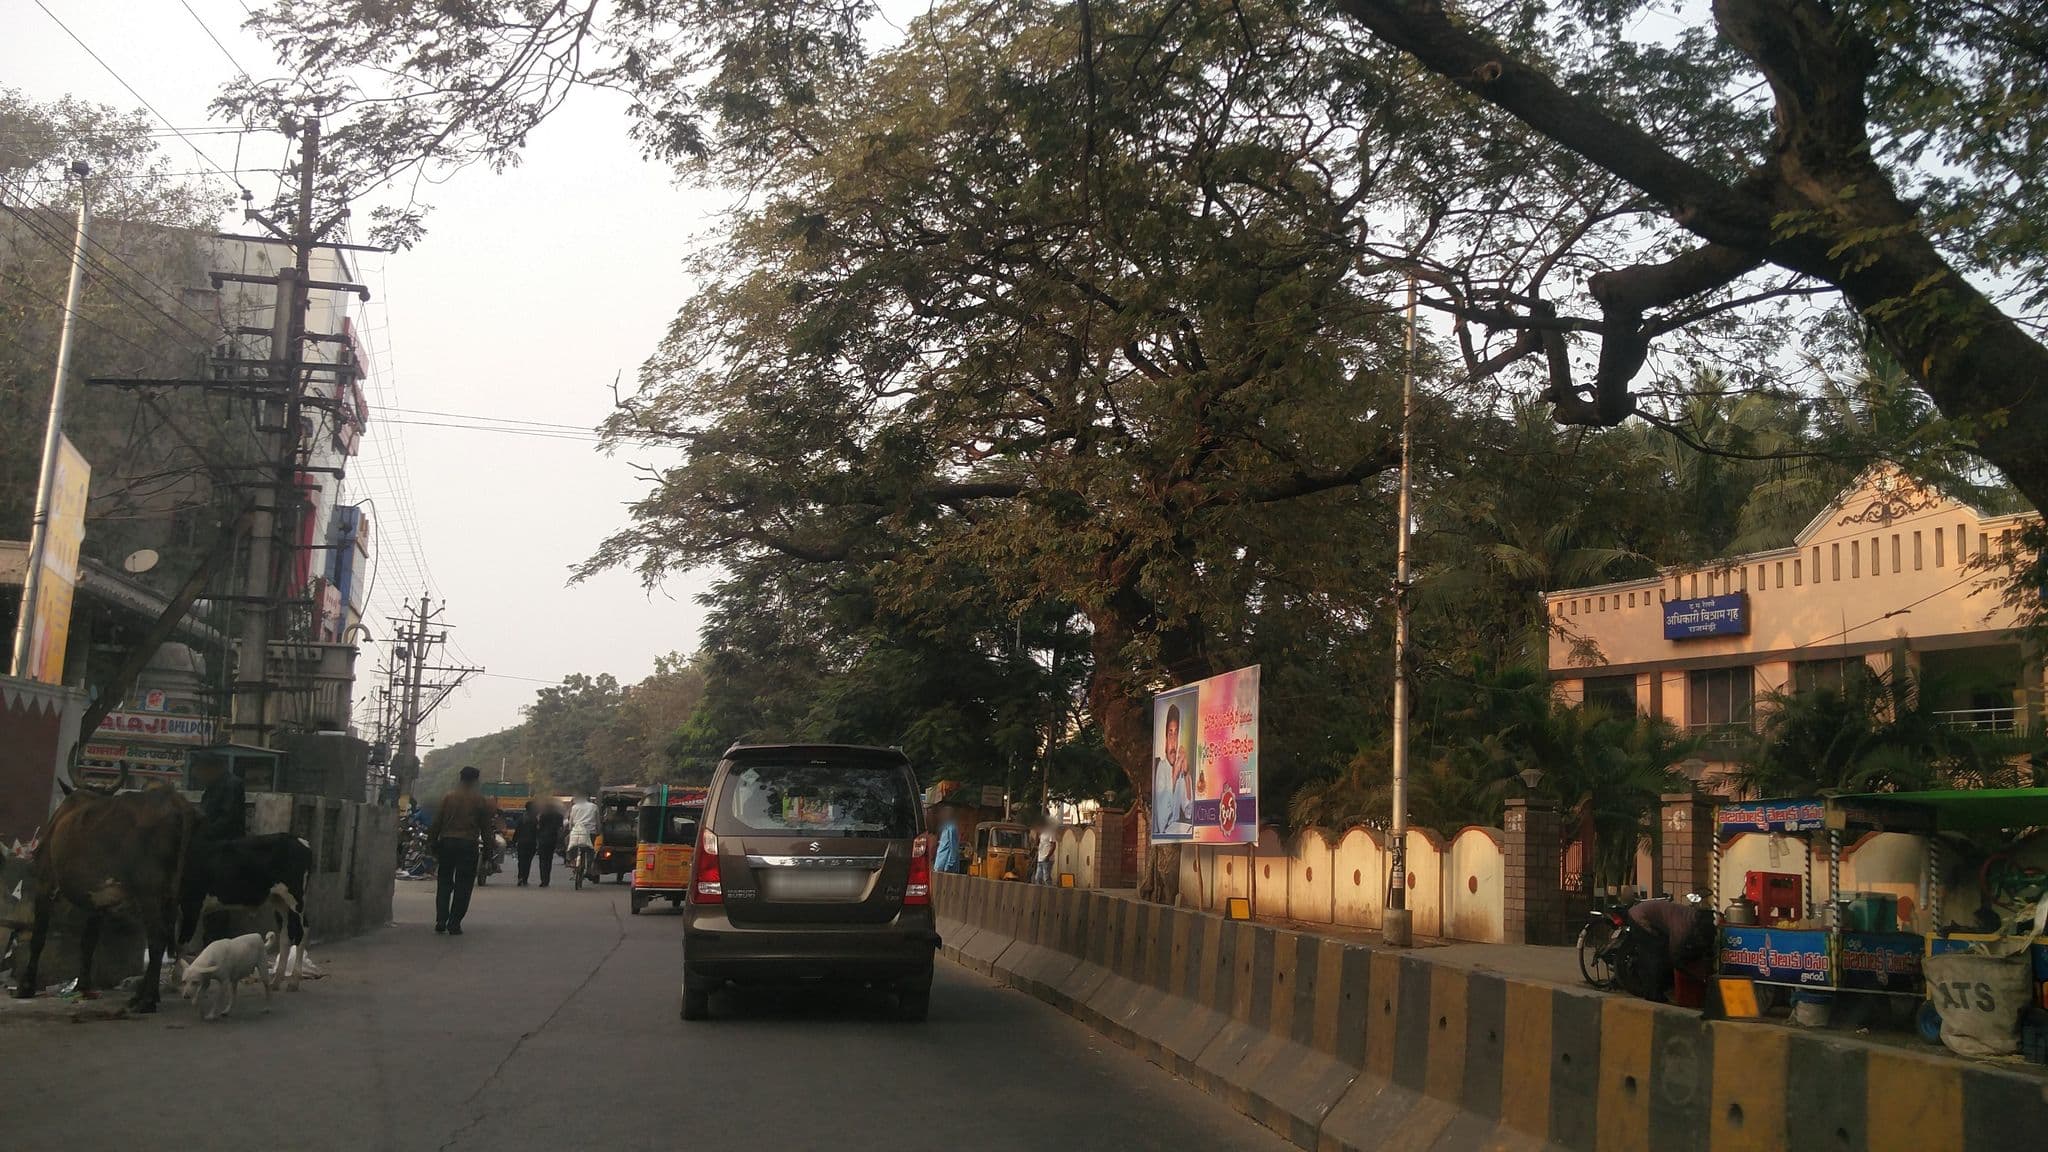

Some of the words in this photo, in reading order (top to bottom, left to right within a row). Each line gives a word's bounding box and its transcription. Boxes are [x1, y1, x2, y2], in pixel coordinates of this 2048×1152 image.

[1666, 609, 1699, 626] अधिकारी
[1700, 607, 1726, 622] विश्राम
[1726, 607, 1740, 622] गृह
[1803, 951, 1830, 972] రసం
[1939, 982, 1995, 1012] ATS
